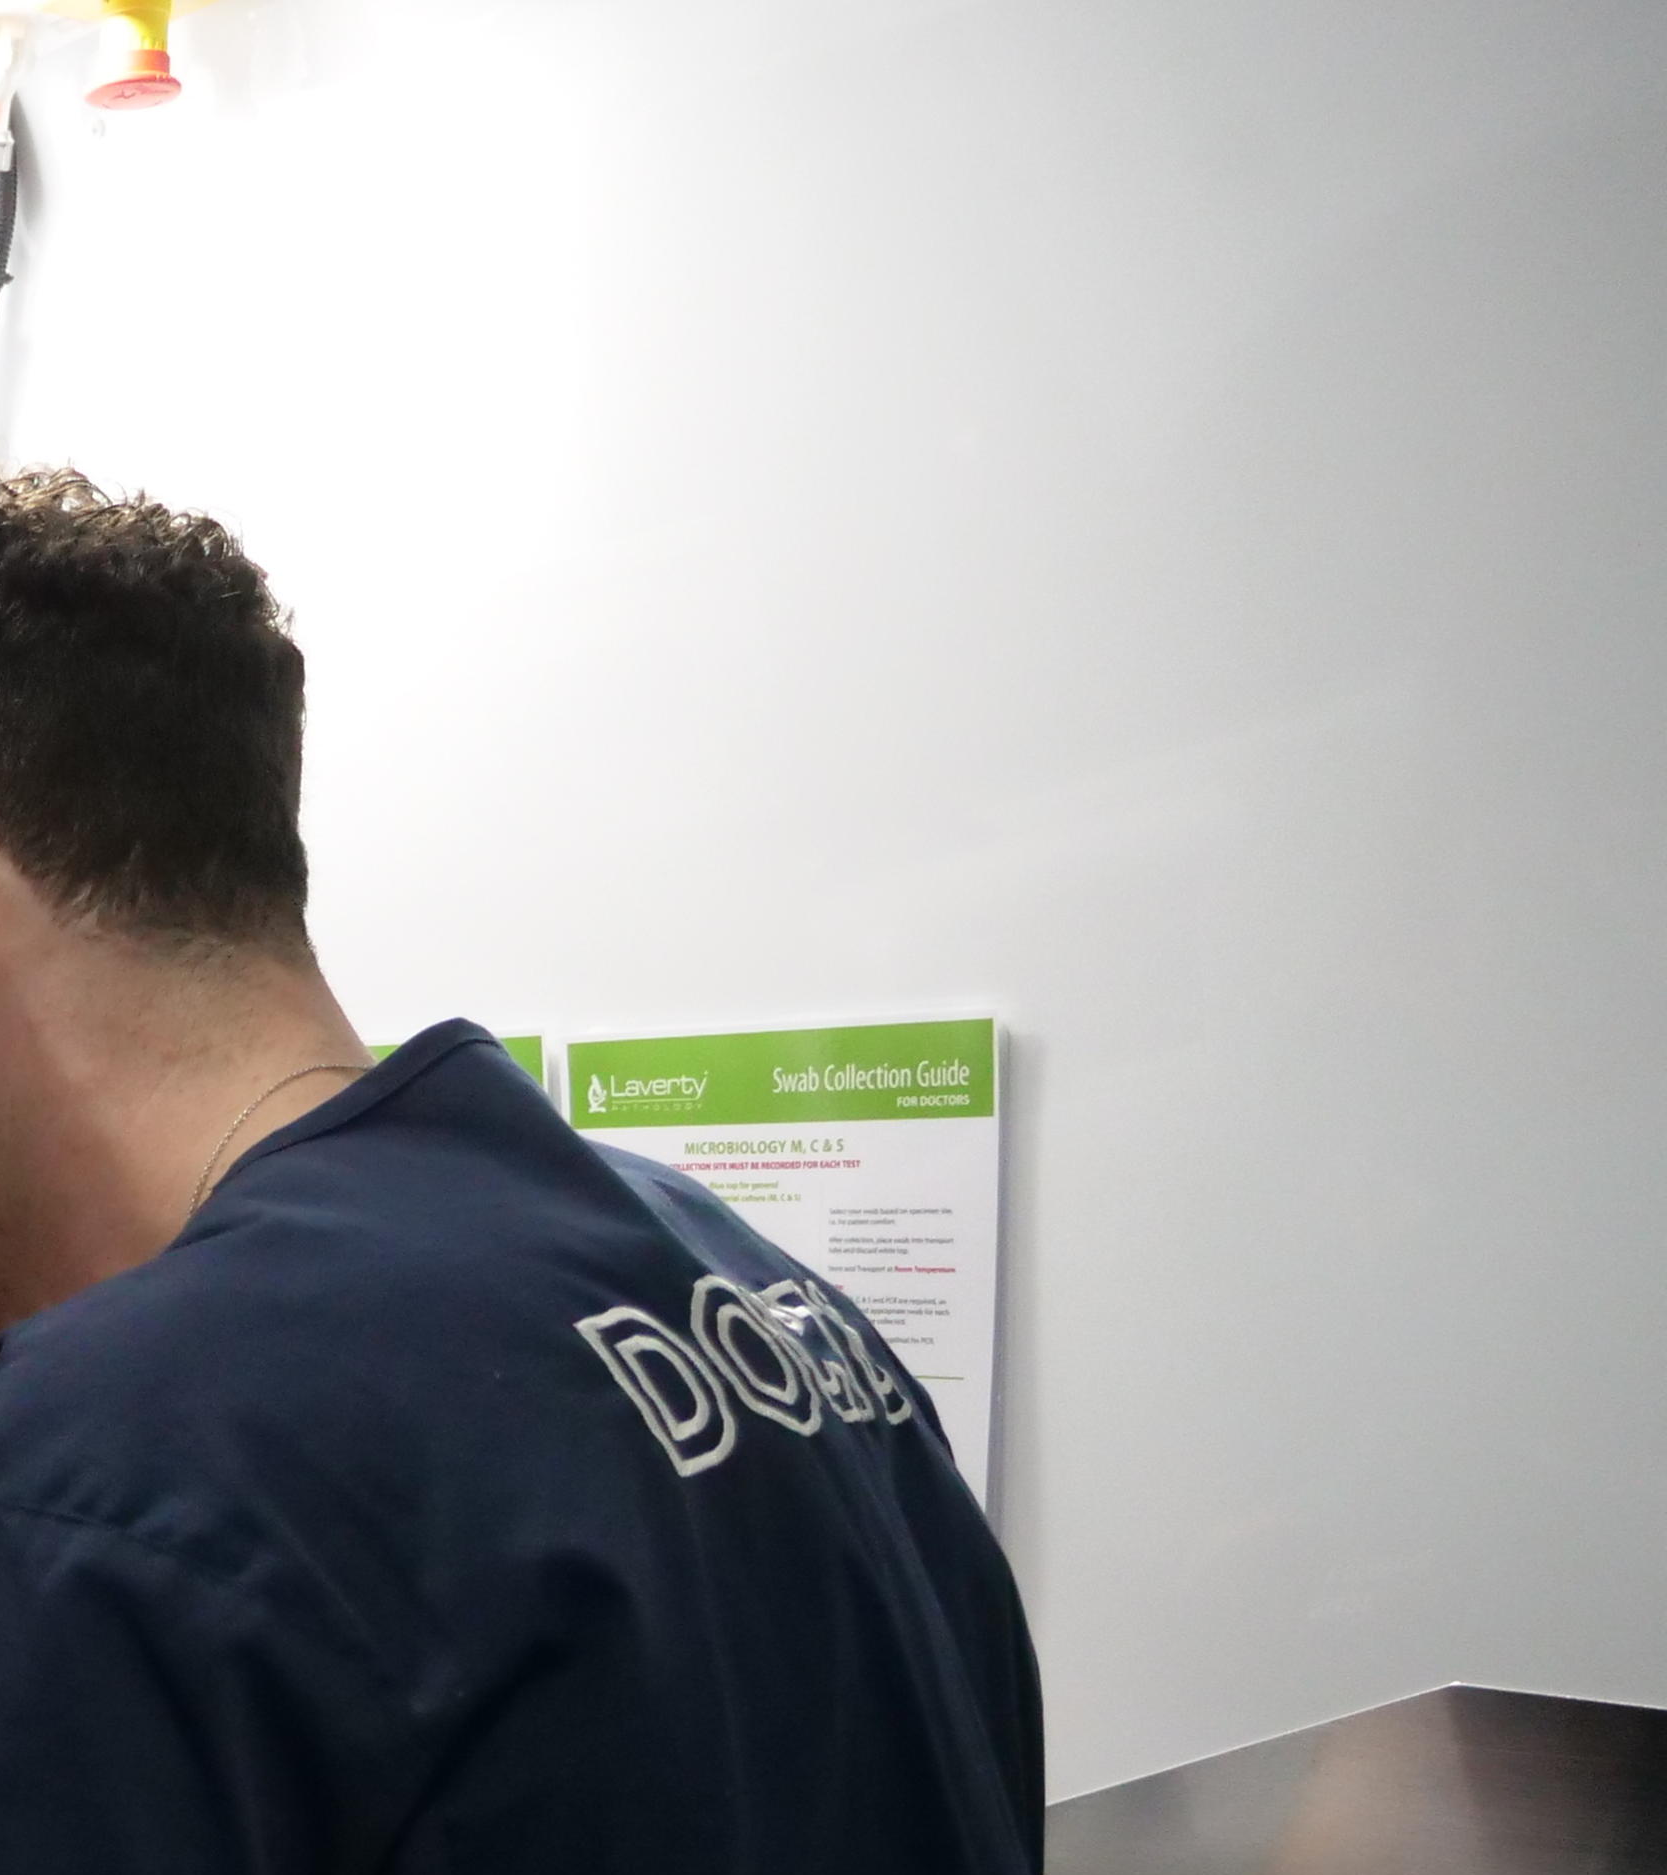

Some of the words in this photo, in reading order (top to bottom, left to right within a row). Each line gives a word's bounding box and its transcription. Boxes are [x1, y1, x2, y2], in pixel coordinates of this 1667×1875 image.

[772, 1067, 820, 1093] Swab
[824, 1063, 911, 1091] Collection
[916, 1059, 970, 1087] Guide
[611, 1071, 708, 1100] Laverty
[896, 1096, 919, 1108] FOR
[920, 1094, 970, 1107] DOCTORS
[684, 1140, 787, 1156] MICROBIOLOGY
[790, 1139, 807, 1154] M,
[810, 1139, 820, 1153] C
[823, 1139, 834, 1152] &
[836, 1138, 844, 1152] S
[713, 1163, 728, 1171] SITE
[729, 1162, 749, 1170] MUST
[750, 1162, 760, 1170] BE
[761, 1161, 802, 1170] RECORDED
[803, 1160, 819, 1169] FOR
[820, 1160, 841, 1169] EACH
[842, 1159, 861, 1168] TEST
